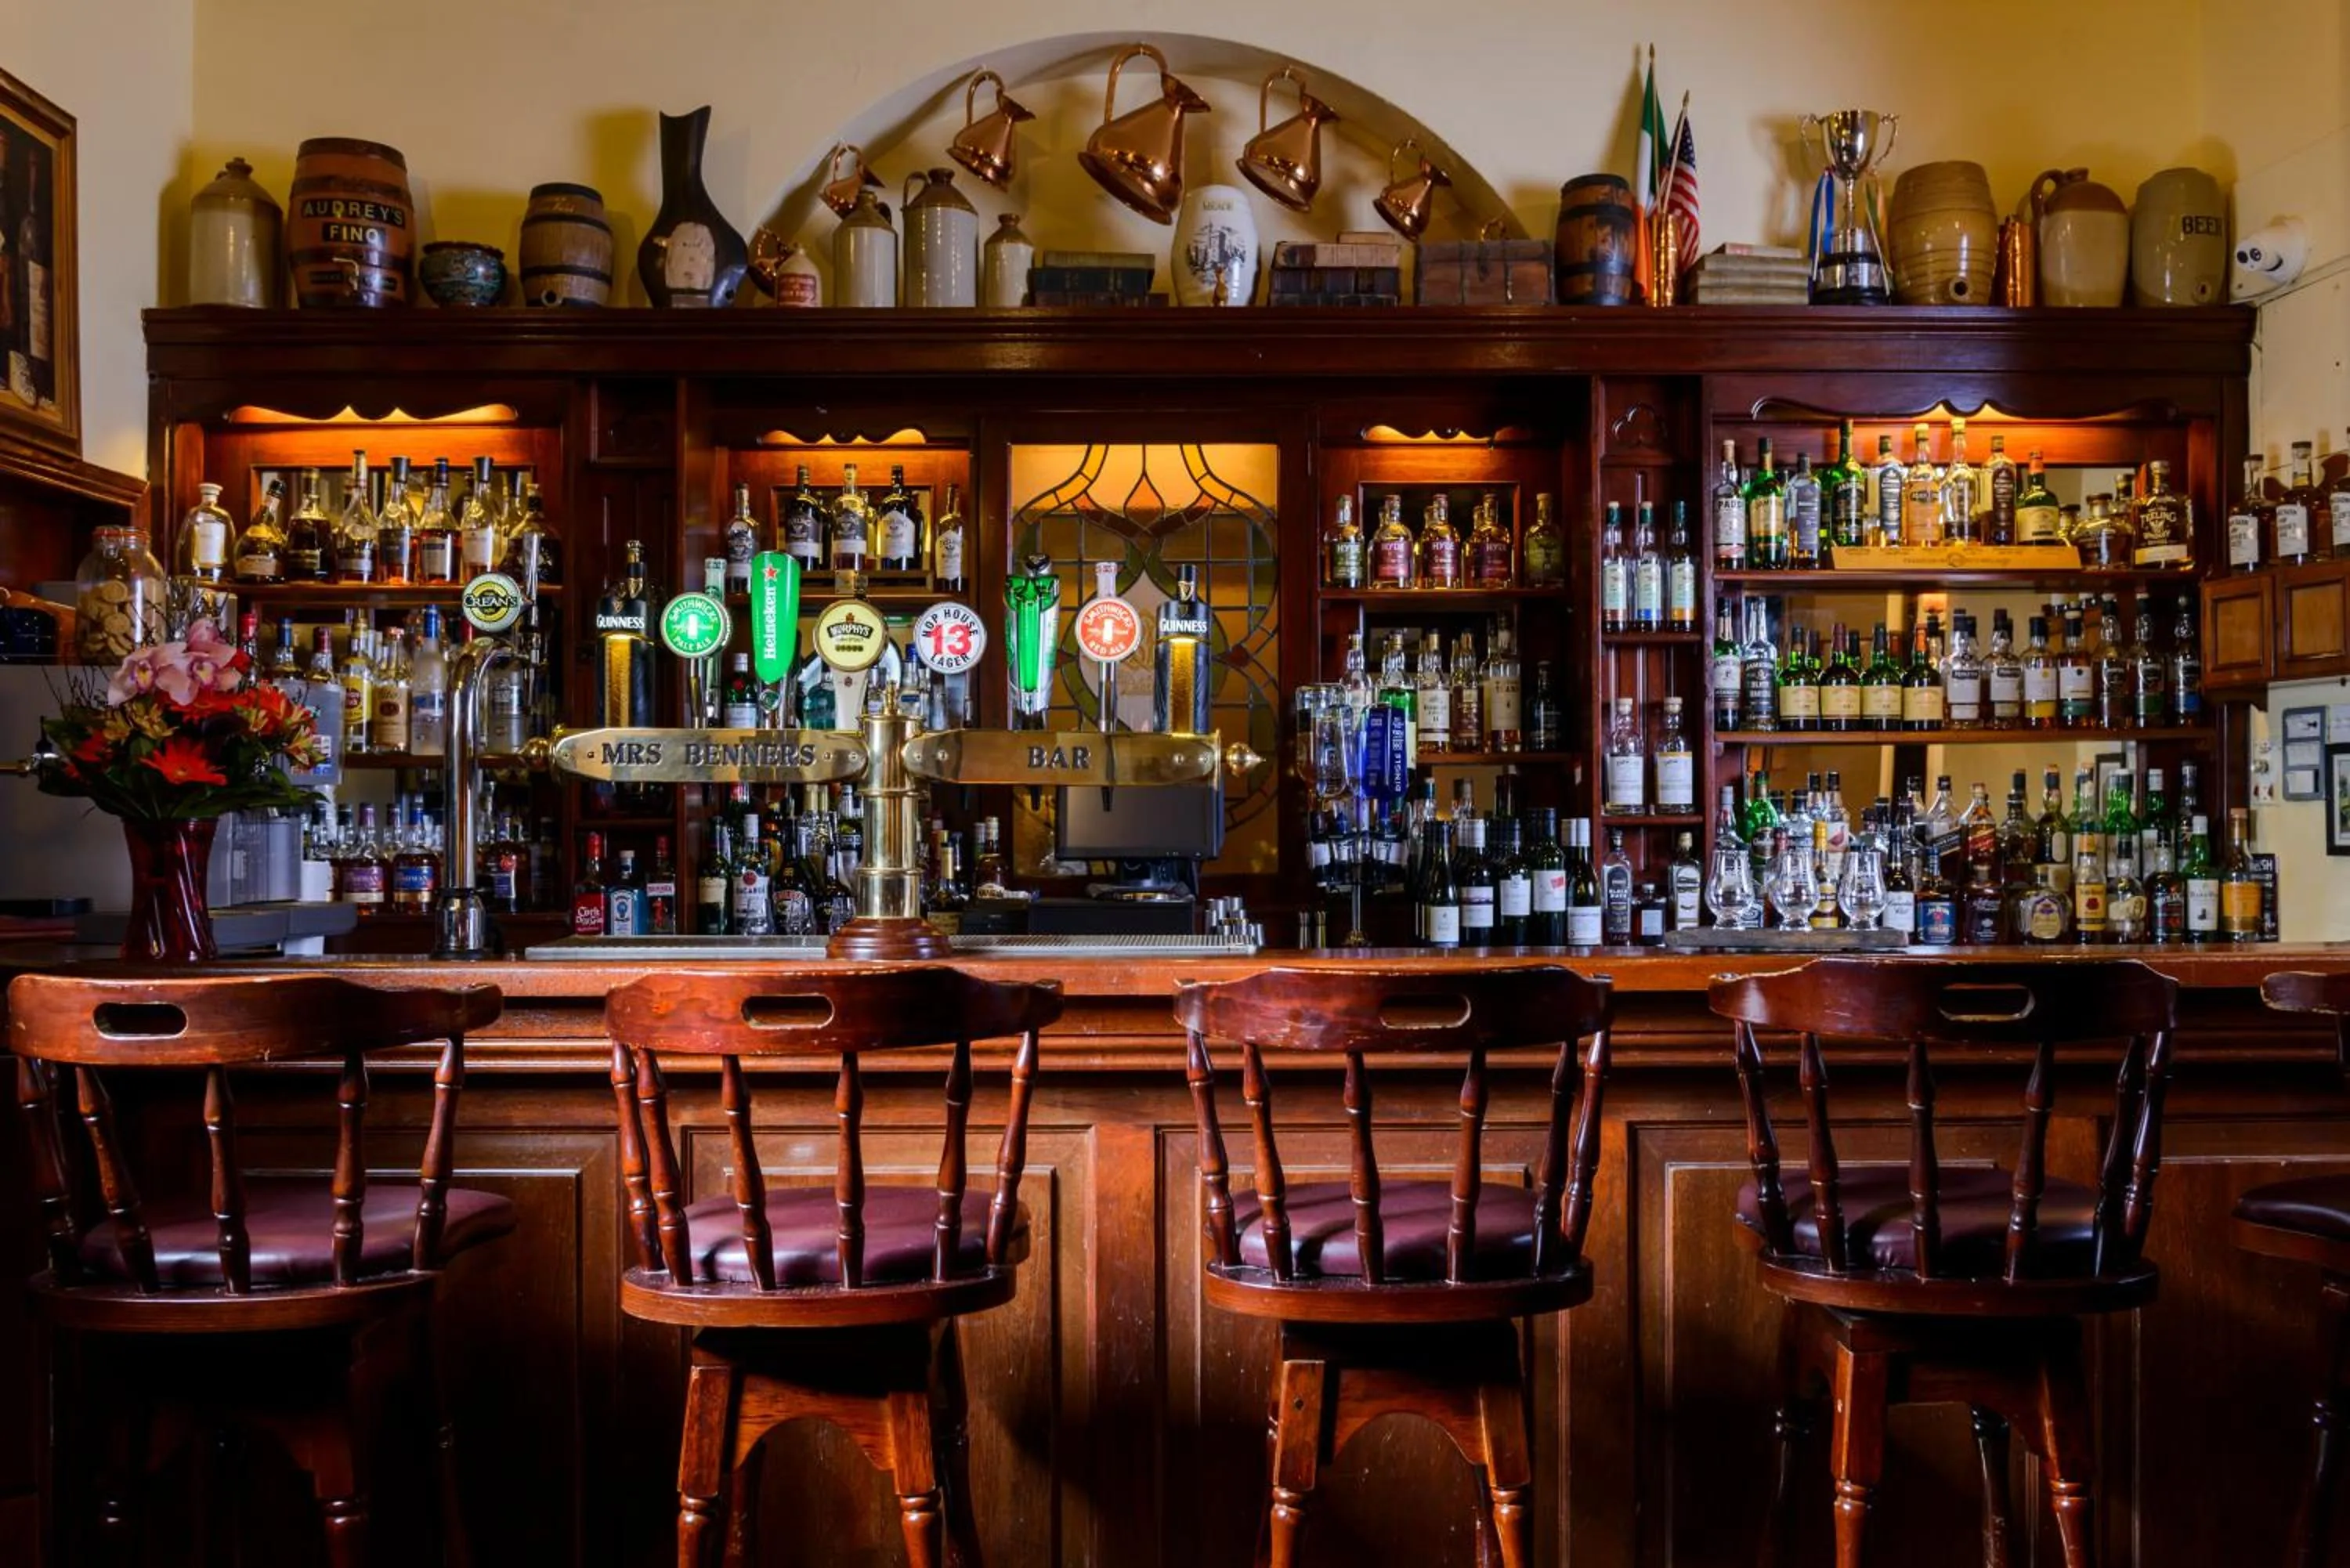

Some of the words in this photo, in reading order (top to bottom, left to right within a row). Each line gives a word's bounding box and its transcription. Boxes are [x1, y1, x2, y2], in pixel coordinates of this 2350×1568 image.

[329, 225, 380, 243] FINO
[1717, 500, 1744, 509] PADD
[596, 613, 645, 629] GUINNESS
[764, 585, 777, 660] Heineken
[921, 613, 938, 638] HOP
[943, 609, 978, 637] HOUSE
[1159, 617, 1208, 633] GUINNESS
[930, 623, 972, 656] 13
[931, 652, 970, 668] LAGER
[601, 742, 662, 765] MRS
[685, 743, 816, 766] BENNERS
[1027, 745, 1091, 770] BAR
[577, 906, 601, 916] Cork
